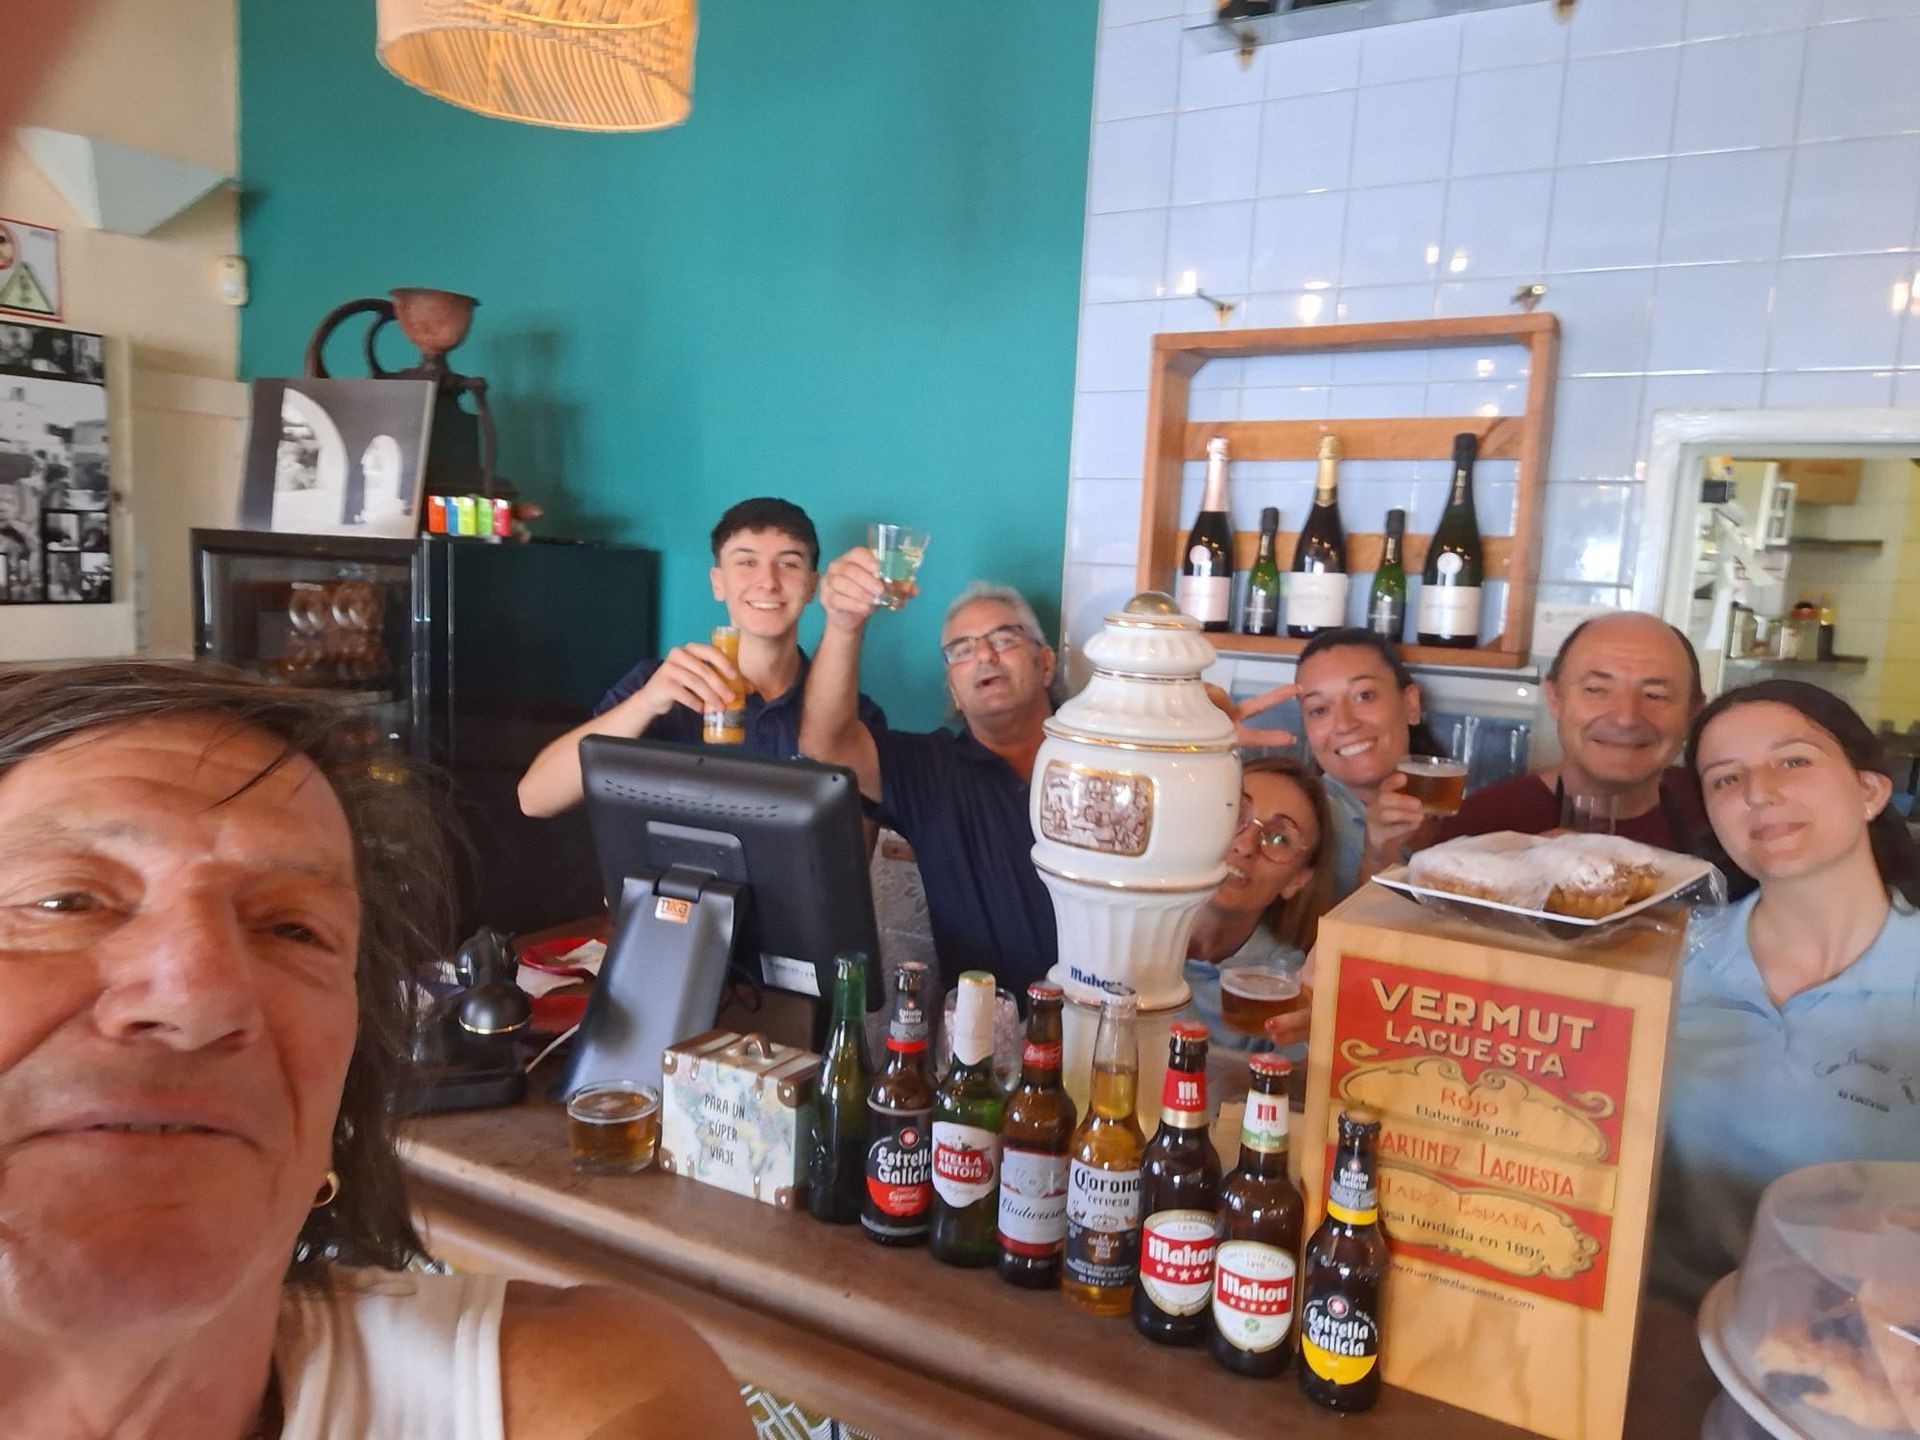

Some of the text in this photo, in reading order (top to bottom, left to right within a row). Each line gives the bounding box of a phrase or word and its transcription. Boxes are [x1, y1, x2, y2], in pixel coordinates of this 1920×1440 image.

[1070, 965, 1122, 989] Maho
[1372, 978, 1594, 1050] VERMUT
[1386, 1020, 1565, 1078] LACUESTA
[704, 1093, 745, 1119] PARA UN
[1441, 1087, 1499, 1118] Rojo
[708, 1119, 738, 1142] SÚPER
[1416, 1104, 1521, 1139] Elaborado por
[709, 1144, 734, 1167] VIAJE
[937, 1160, 982, 1178] ARTOIS
[938, 1148, 982, 1167] STELLA
[1478, 1143, 1575, 1199] LACUESTA
[1074, 1167, 1141, 1194] Corona
[1411, 1213, 1474, 1242] fundada
[1479, 1235, 1498, 1249] en
[1222, 1272, 1288, 1303] Mahou
[1308, 1322, 1365, 1357] Galicia
[1309, 1306, 1369, 1342] Estrella
